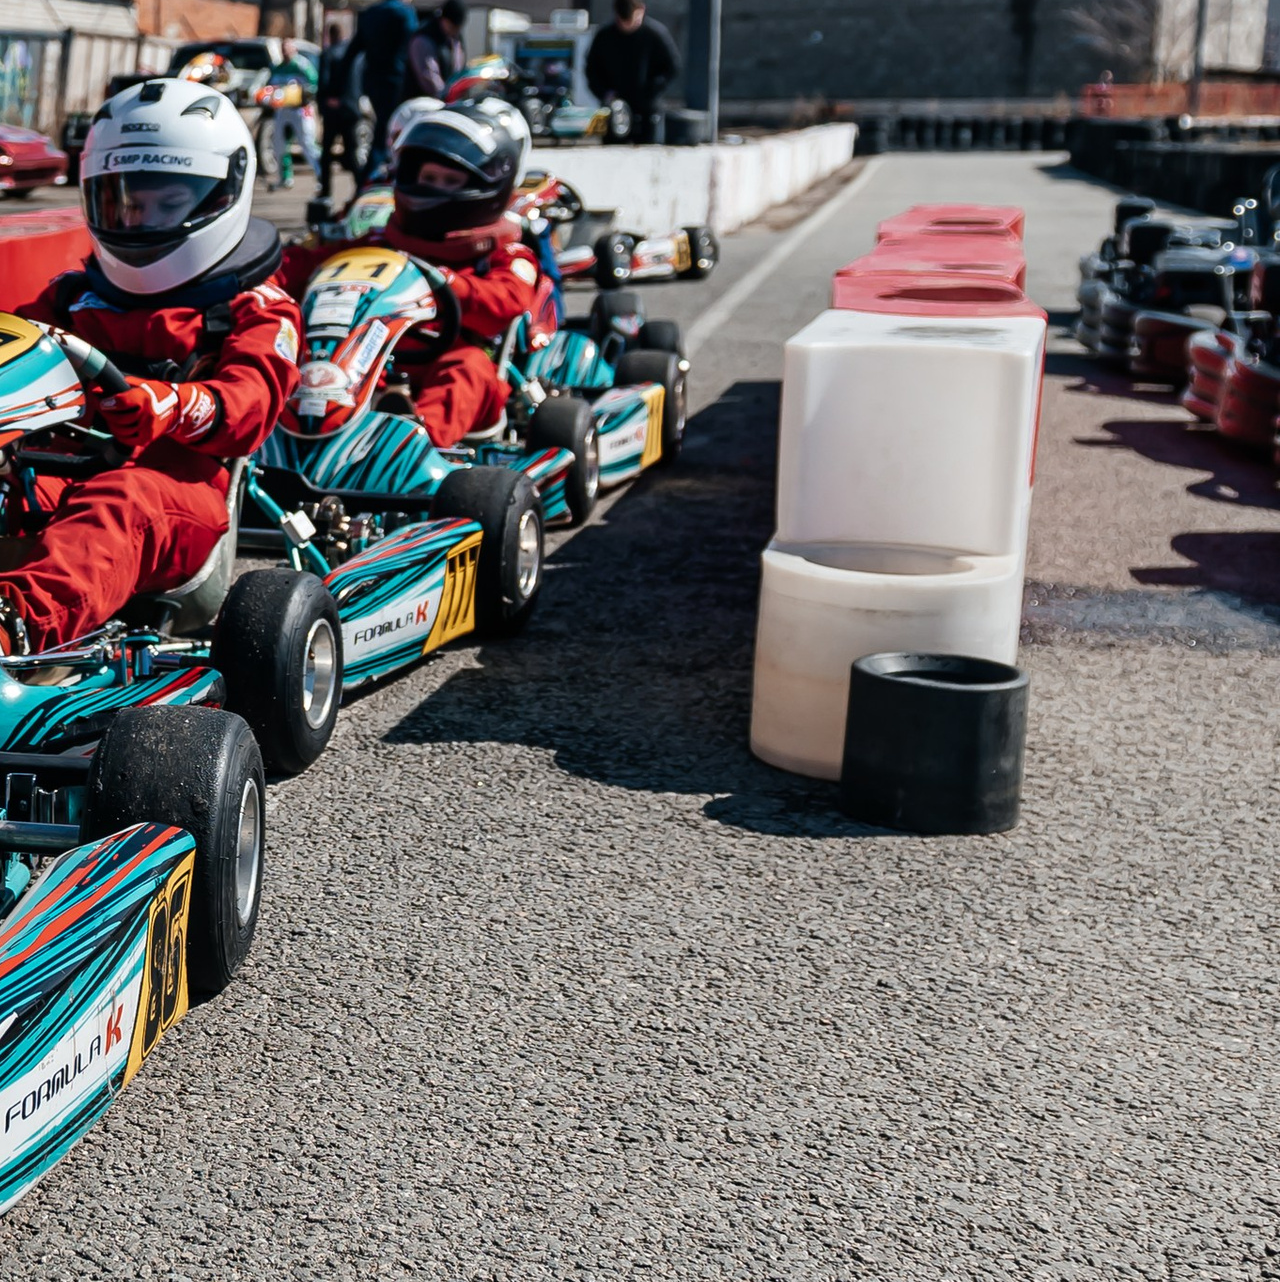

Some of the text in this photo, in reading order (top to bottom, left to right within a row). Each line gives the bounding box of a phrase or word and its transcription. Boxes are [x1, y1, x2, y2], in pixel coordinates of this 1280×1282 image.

[113, 154, 194, 167] SMP RACING
[354, 600, 430, 645] FORMULA K
[5, 1002, 124, 1134] FORMULA K
